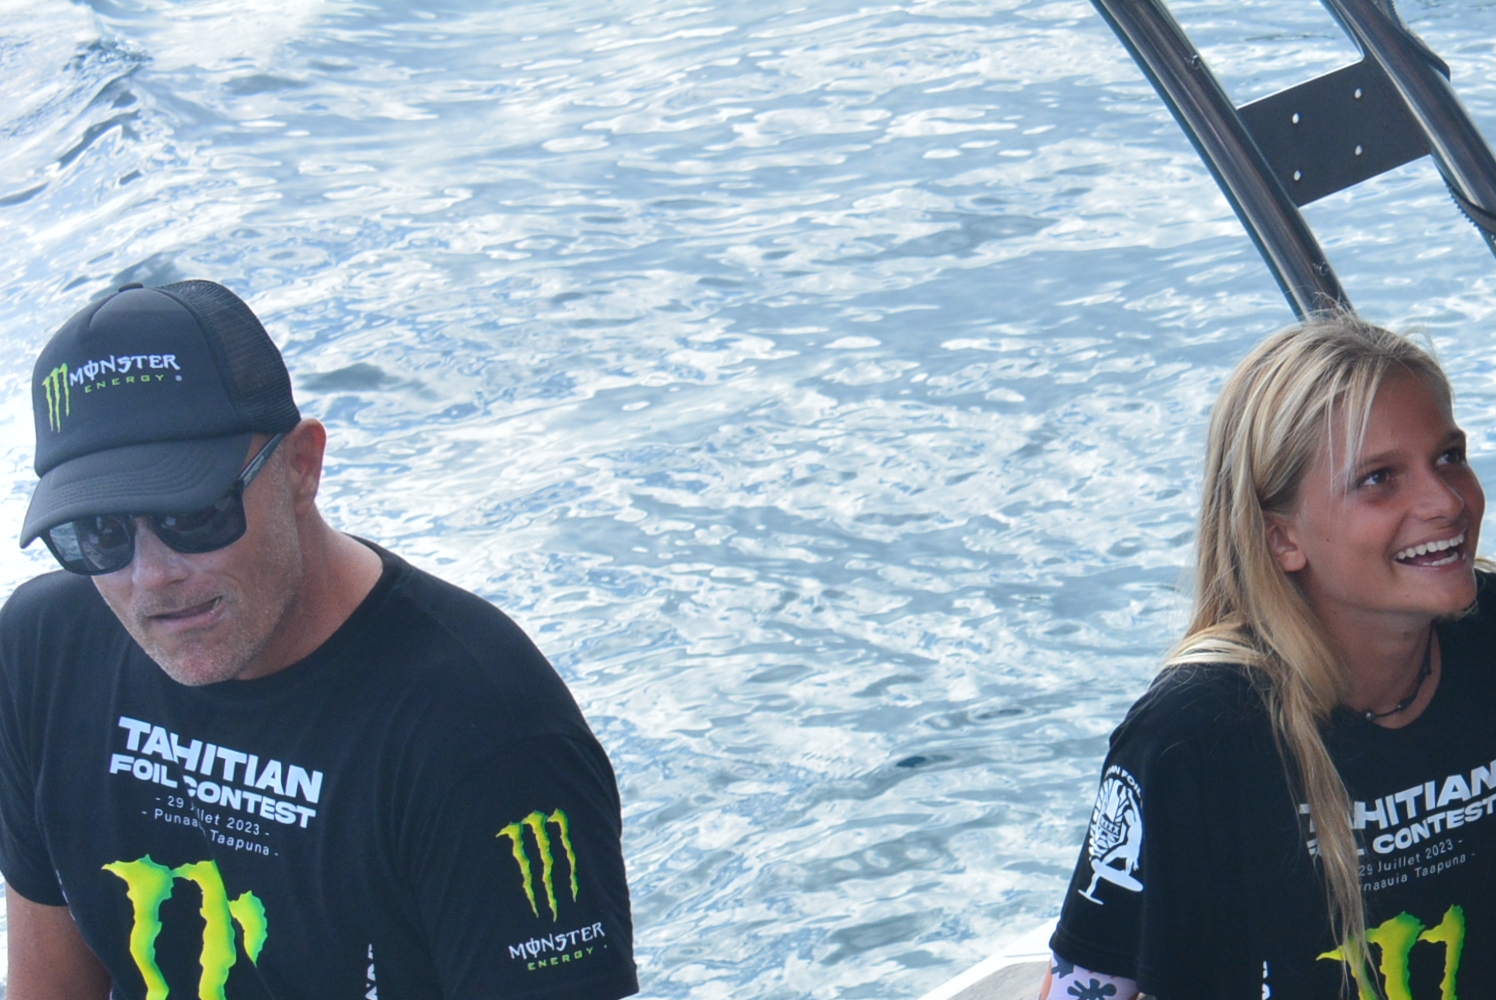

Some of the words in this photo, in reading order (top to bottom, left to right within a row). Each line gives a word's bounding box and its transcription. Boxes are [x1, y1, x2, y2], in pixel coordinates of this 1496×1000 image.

[70, 353, 181, 386] MONSTER
[84, 373, 165, 393] ENERGY
[109, 753, 178, 788] FOIL
[118, 716, 323, 804] TAHITIAN
[167, 795, 184, 809] 29
[226, 817, 260, 836] 2023
[210, 828, 270, 856] Taapuna
[1358, 864, 1373, 877] 29
[1378, 853, 1420, 872] Juillet
[1425, 838, 1454, 859] 2023
[1360, 873, 1407, 891] naauia
[1414, 854, 1466, 878] Taapuna
[508, 922, 606, 960] MONSTER
[527, 946, 594, 971] ENERGY
